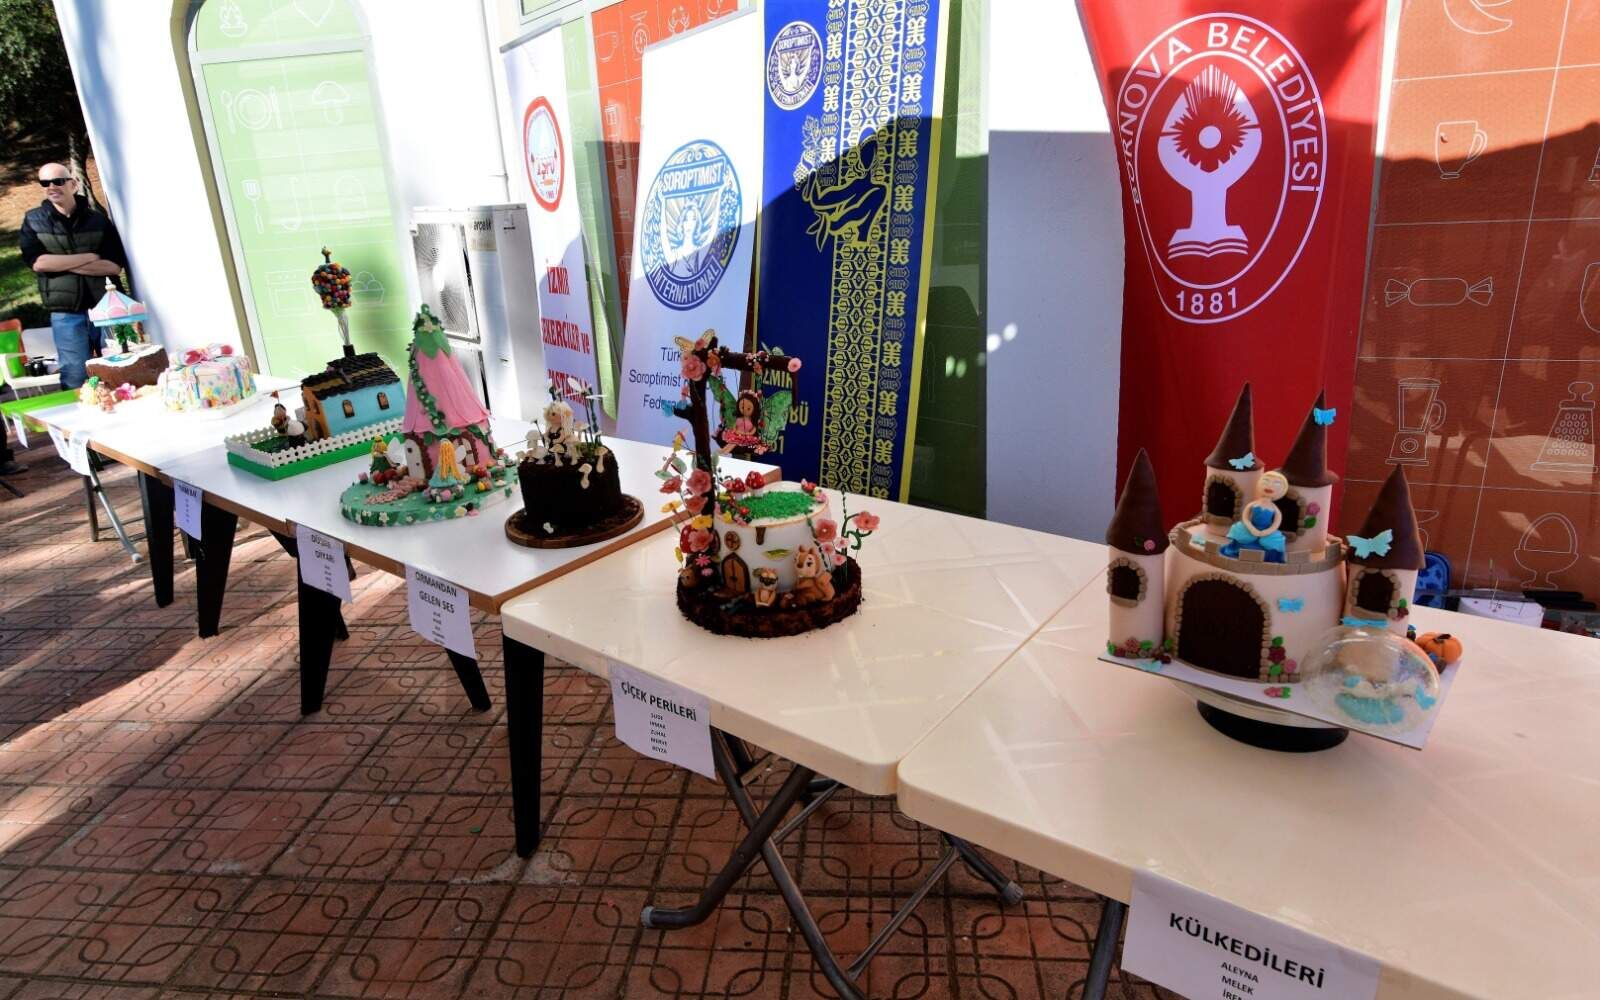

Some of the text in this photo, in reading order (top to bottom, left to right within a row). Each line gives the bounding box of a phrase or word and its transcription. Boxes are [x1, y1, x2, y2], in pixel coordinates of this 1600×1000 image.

[1207, 22, 1323, 193] BELEDİYESİ
[663, 162, 724, 194] SOROPTIMIST
[651, 260, 720, 305] INTERNATIONAL
[1176, 287, 1237, 315] 1881
[629, 369, 680, 388] Soroptimist
[415, 571, 457, 598] ORMANDAN
[419, 590, 455, 614] GELEN SES
[621, 681, 697, 722] ÇİÇEK PERİLERİ
[1169, 912, 1325, 989] KÜLKEDİLERİ
[1220, 961, 1259, 984] ALEYNA
[1221, 975, 1254, 996] MELEK
